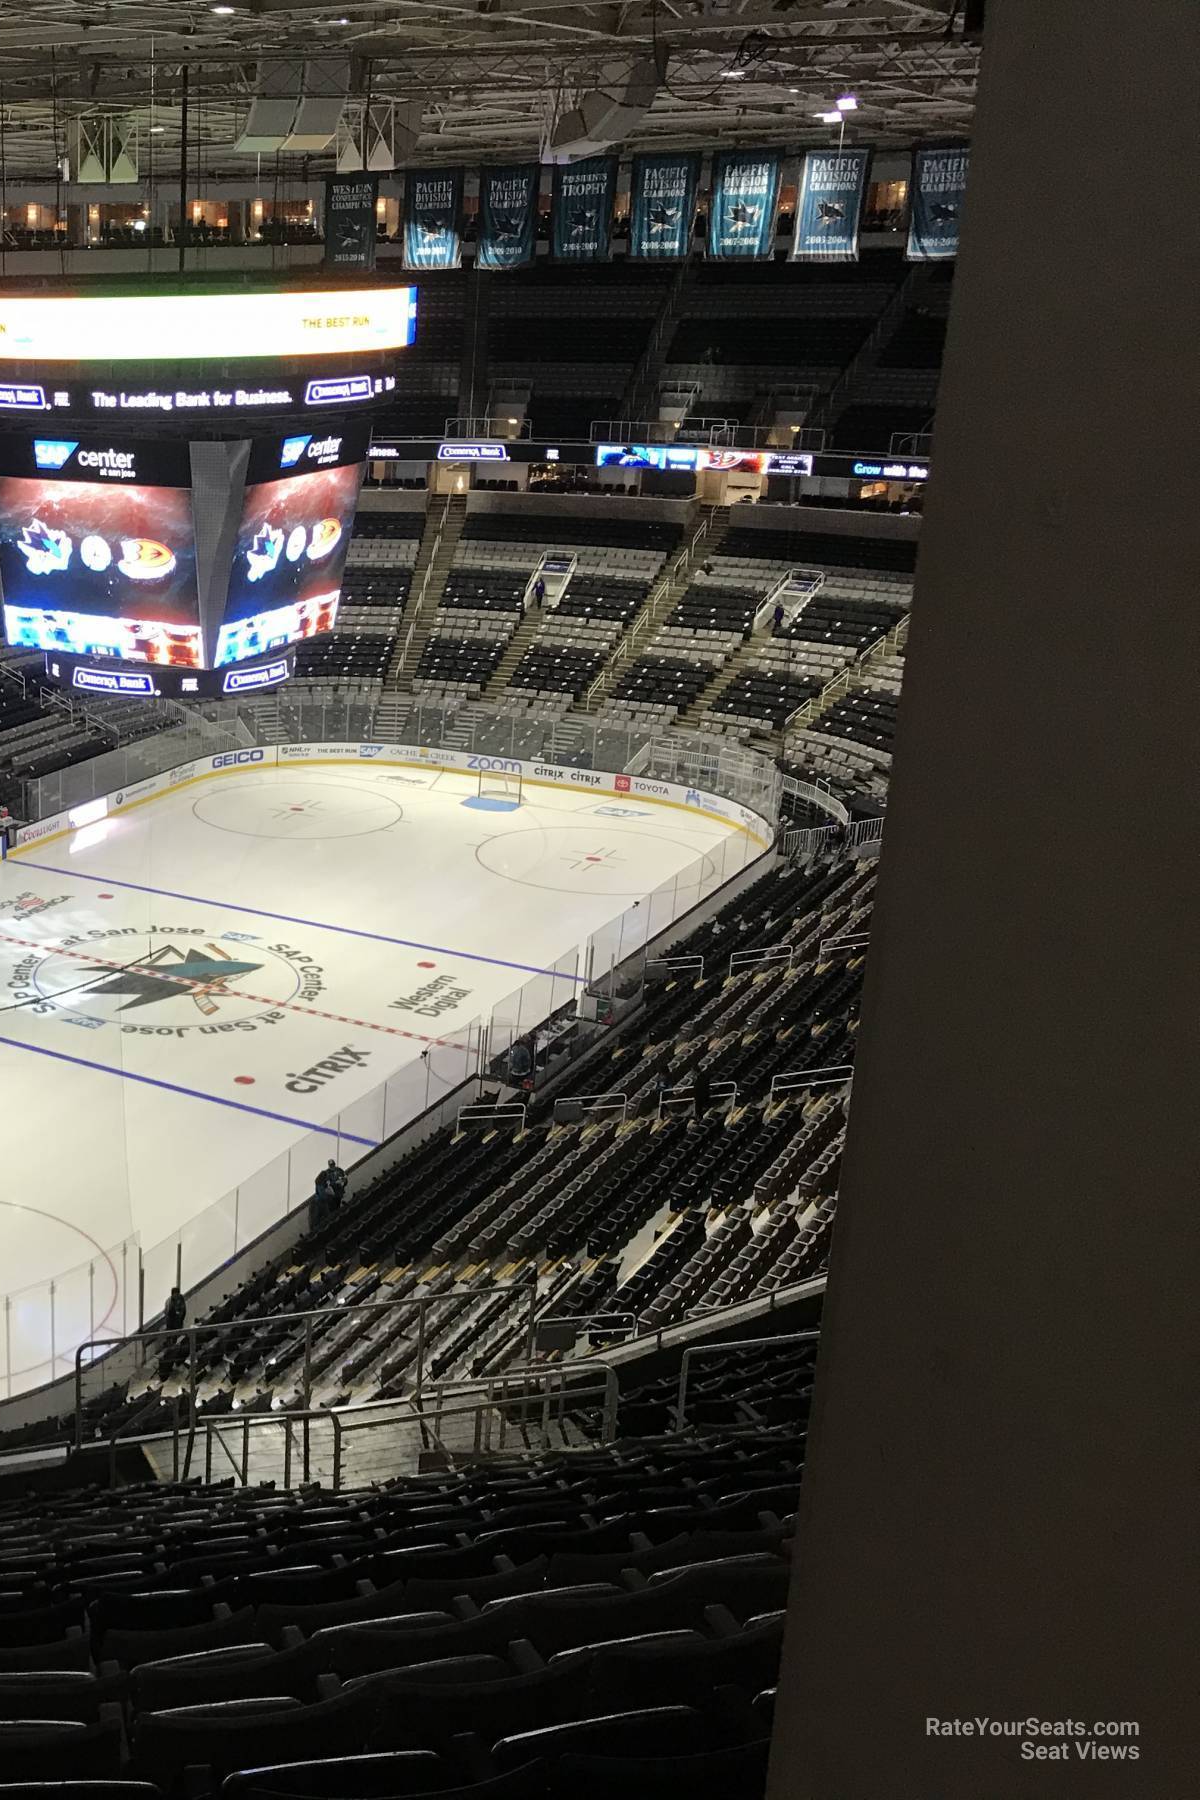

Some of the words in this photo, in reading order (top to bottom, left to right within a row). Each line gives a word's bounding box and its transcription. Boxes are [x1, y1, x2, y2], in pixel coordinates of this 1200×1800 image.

[725, 162, 769, 176] PACIFIC
[812, 158, 860, 172] PACIFIC
[645, 166, 688, 179] PACIFIC
[811, 170, 858, 182] DIVISION
[921, 170, 965, 183] DIVISIO
[416, 180, 453, 193] PACIFIC
[490, 178, 528, 191] PACIFIC
[644, 178, 686, 190] DIVISION
[724, 174, 768, 186] DIVISION
[810, 182, 857, 191] CHAMPIONS
[332, 183, 372, 194] WESTERN
[561, 182, 607, 197] TROPHY
[643, 188, 685, 198] CHAMPIONS
[723, 184, 767, 196] CHAMPIONS
[920, 183, 966, 192] CHAMPION
[415, 192, 452, 204] DIVISION
[490, 190, 528, 202] DIVISION
[331, 201, 372, 210] CHAMPIONS
[415, 202, 452, 210] CHAMPIONS
[489, 200, 527, 208] CHAMPIONS
[302, 318, 322, 328] THE
[326, 317, 350, 328] BEST
[353, 316, 370, 326] RUN
[92, 392, 116, 408] The
[120, 392, 172, 411] Leading
[176, 391, 210, 406] Bank
[214, 390, 232, 406] for
[235, 389, 293, 405] Business.
[282, 442, 306, 460] SAP
[308, 436, 342, 458] center
[368, 446, 400, 457] siness.
[480, 448, 500, 456] Bank
[36, 445, 68, 464] SAP
[78, 448, 134, 469] center
[100, 469, 107, 477] at
[121, 470, 136, 479] jose
[854, 462, 882, 476] Grow
[884, 466, 906, 478] with
[908, 466, 928, 479] the
[269, 664, 286, 680] Bank
[120, 676, 146, 690] Bank
[212, 750, 264, 768] GEICO
[430, 752, 456, 761] CREEK
[634, 782, 669, 796] TOYOTA
[12, 895, 76, 921] AMERICA
[14, 904, 22, 912] 4
[87, 926, 136, 940] San
[149, 924, 205, 936] Jose
[60, 934, 86, 946] at
[267, 943, 312, 965] SAP
[8, 954, 42, 989] Center
[298, 965, 328, 1002] Center
[388, 974, 457, 1012] Western
[14, 992, 56, 1014] SP
[414, 986, 471, 1018] Digital
[256, 1010, 286, 1024] at
[120, 1024, 186, 1038] Jose
[201, 1022, 258, 1036] San
